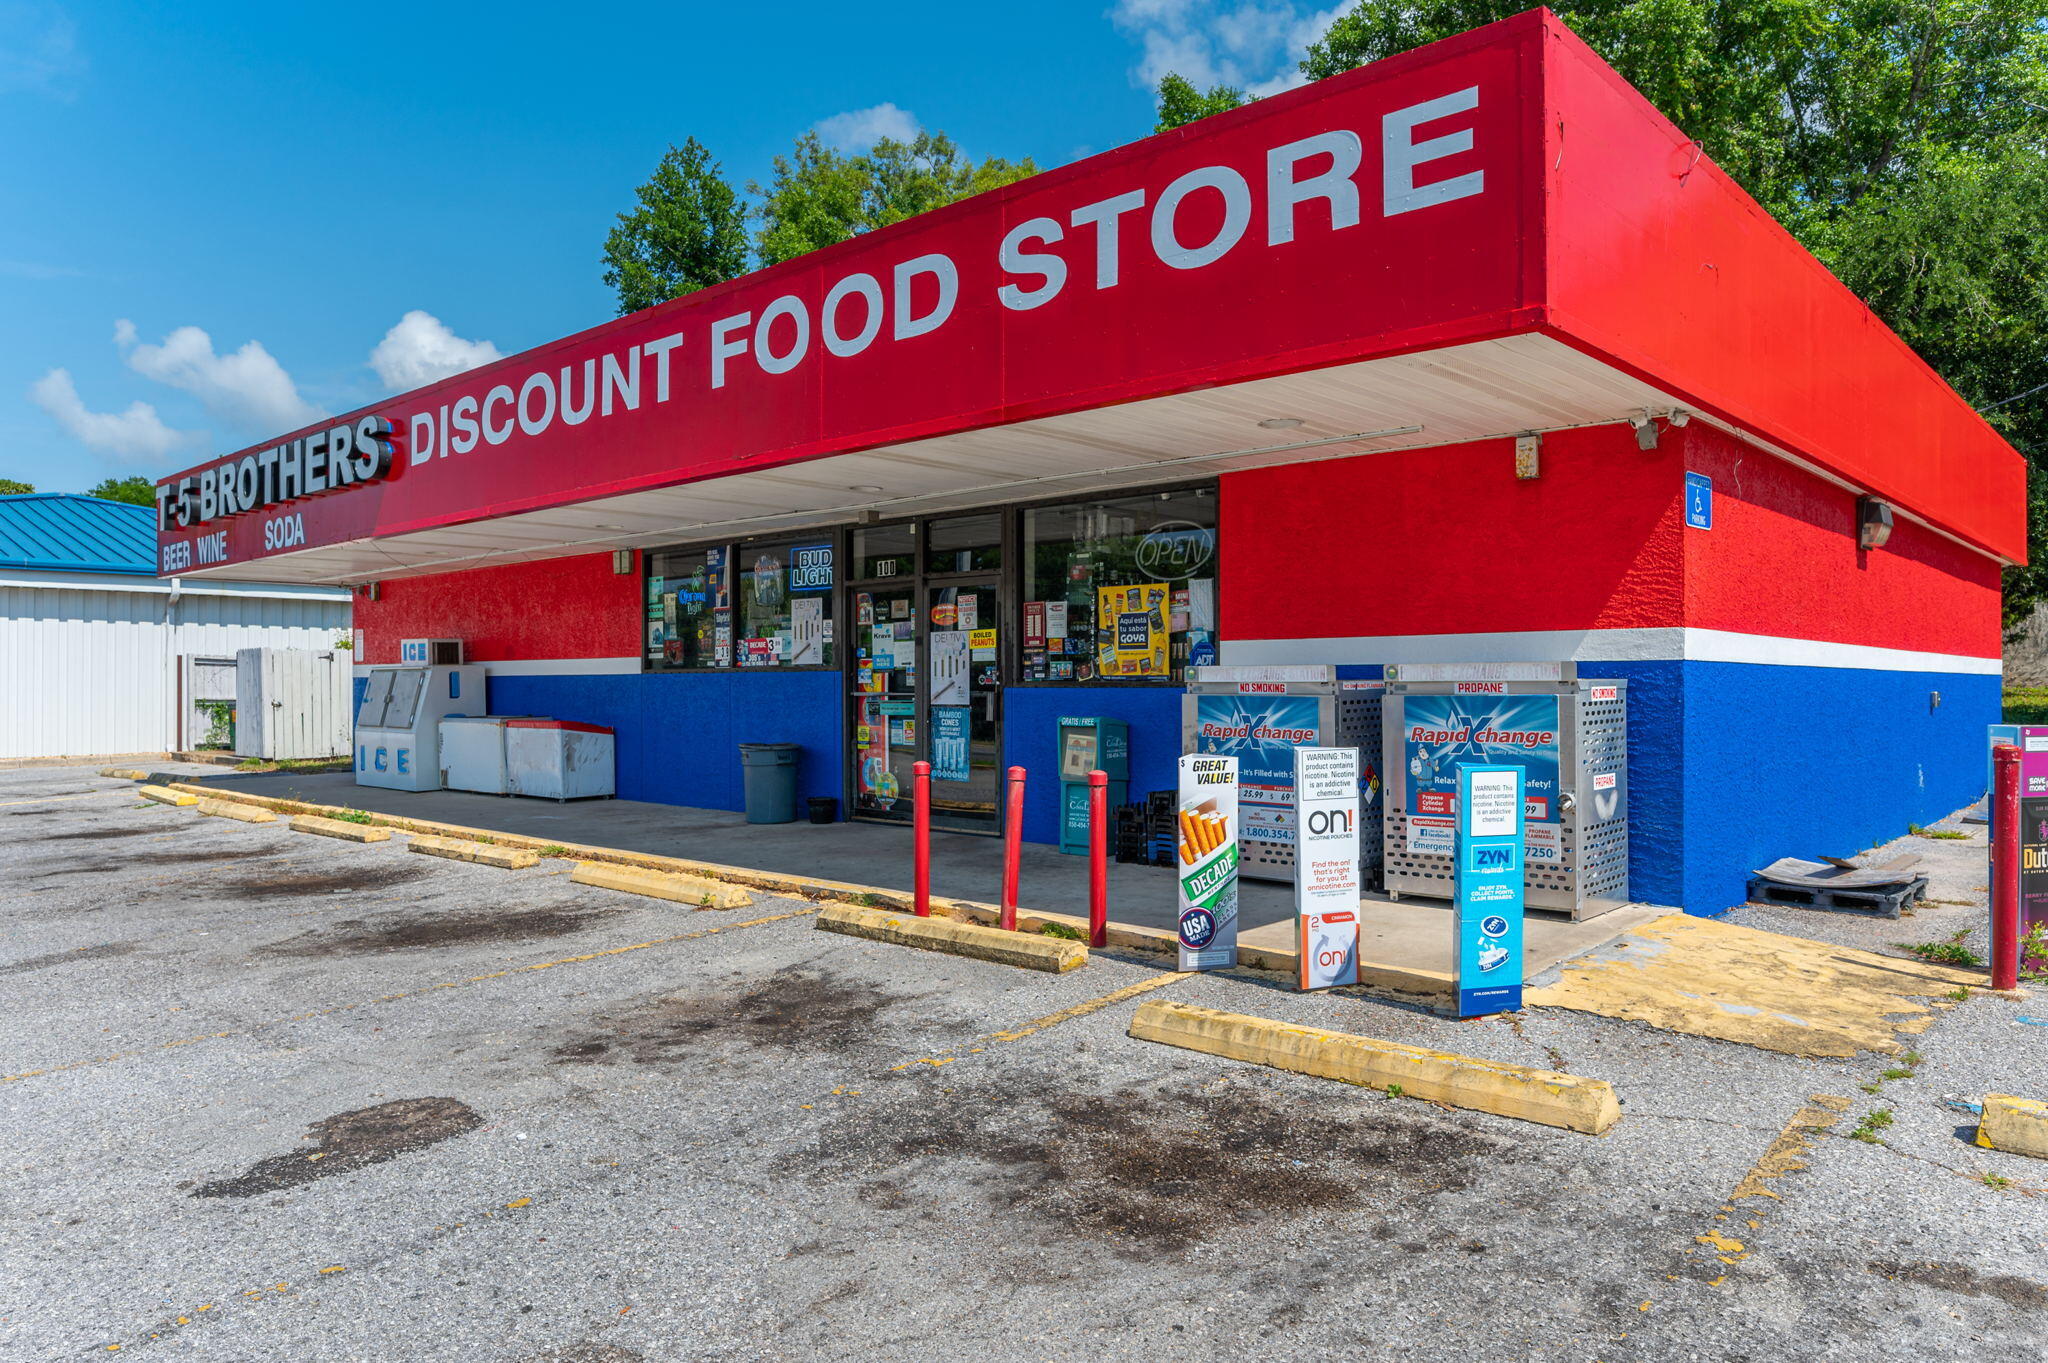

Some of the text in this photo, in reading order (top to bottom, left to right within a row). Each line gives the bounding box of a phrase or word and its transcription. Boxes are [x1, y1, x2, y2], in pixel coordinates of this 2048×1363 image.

[410, 85, 1484, 466] DISCOUNT FOOD STORE
[156, 415, 388, 531] T-5 BROTHERS
[265, 512, 305, 551] SODA
[163, 530, 228, 572] BEER WINE
[1139, 534, 1205, 566] OPEN
[800, 549, 833, 569] BUD
[878, 560, 895, 576] 100
[970, 638, 995, 647] PEANUTS
[1120, 633, 1146, 643] GOYA
[402, 643, 426, 661] ICE
[1194, 654, 1214, 667] ADT
[1239, 683, 1285, 693] NO SMOKING
[1458, 683, 1503, 693] PROPANE
[1592, 688, 1616, 699] NO SMOKING
[941, 718, 960, 727] CONES
[1061, 717, 1079, 726] GRATIS
[1081, 717, 1095, 726] FREE
[360, 745, 410, 774] ICE
[1307, 752, 1352, 761] WARNING: This
[1193, 760, 1228, 772] GREAT
[1305, 763, 1328, 771] product
[1197, 772, 1235, 785] VALUE!
[1254, 769, 1272, 777] Filled
[1273, 770, 1288, 778] with
[1325, 780, 1351, 788] addictive
[1434, 775, 1551, 789] Relax afety!
[1595, 776, 1615, 787] PROPANE
[2029, 777, 2046, 785] SAVE
[1244, 789, 1263, 799] 25.99
[1308, 809, 1352, 835] on!
[1246, 827, 1295, 840] 1.800.354.7
[1477, 849, 1510, 865] ZYN
[2024, 847, 2048, 869] Dut
[1189, 853, 1236, 896] DECADE
[1314, 867, 1350, 876] that's right
[1307, 881, 1357, 891] onnicotine.com
[1327, 876, 1339, 884] you
[1183, 915, 1210, 937] USA
[1311, 916, 1320, 928] 2
[1190, 929, 1211, 942] MADE
[1319, 949, 1346, 967] on!
